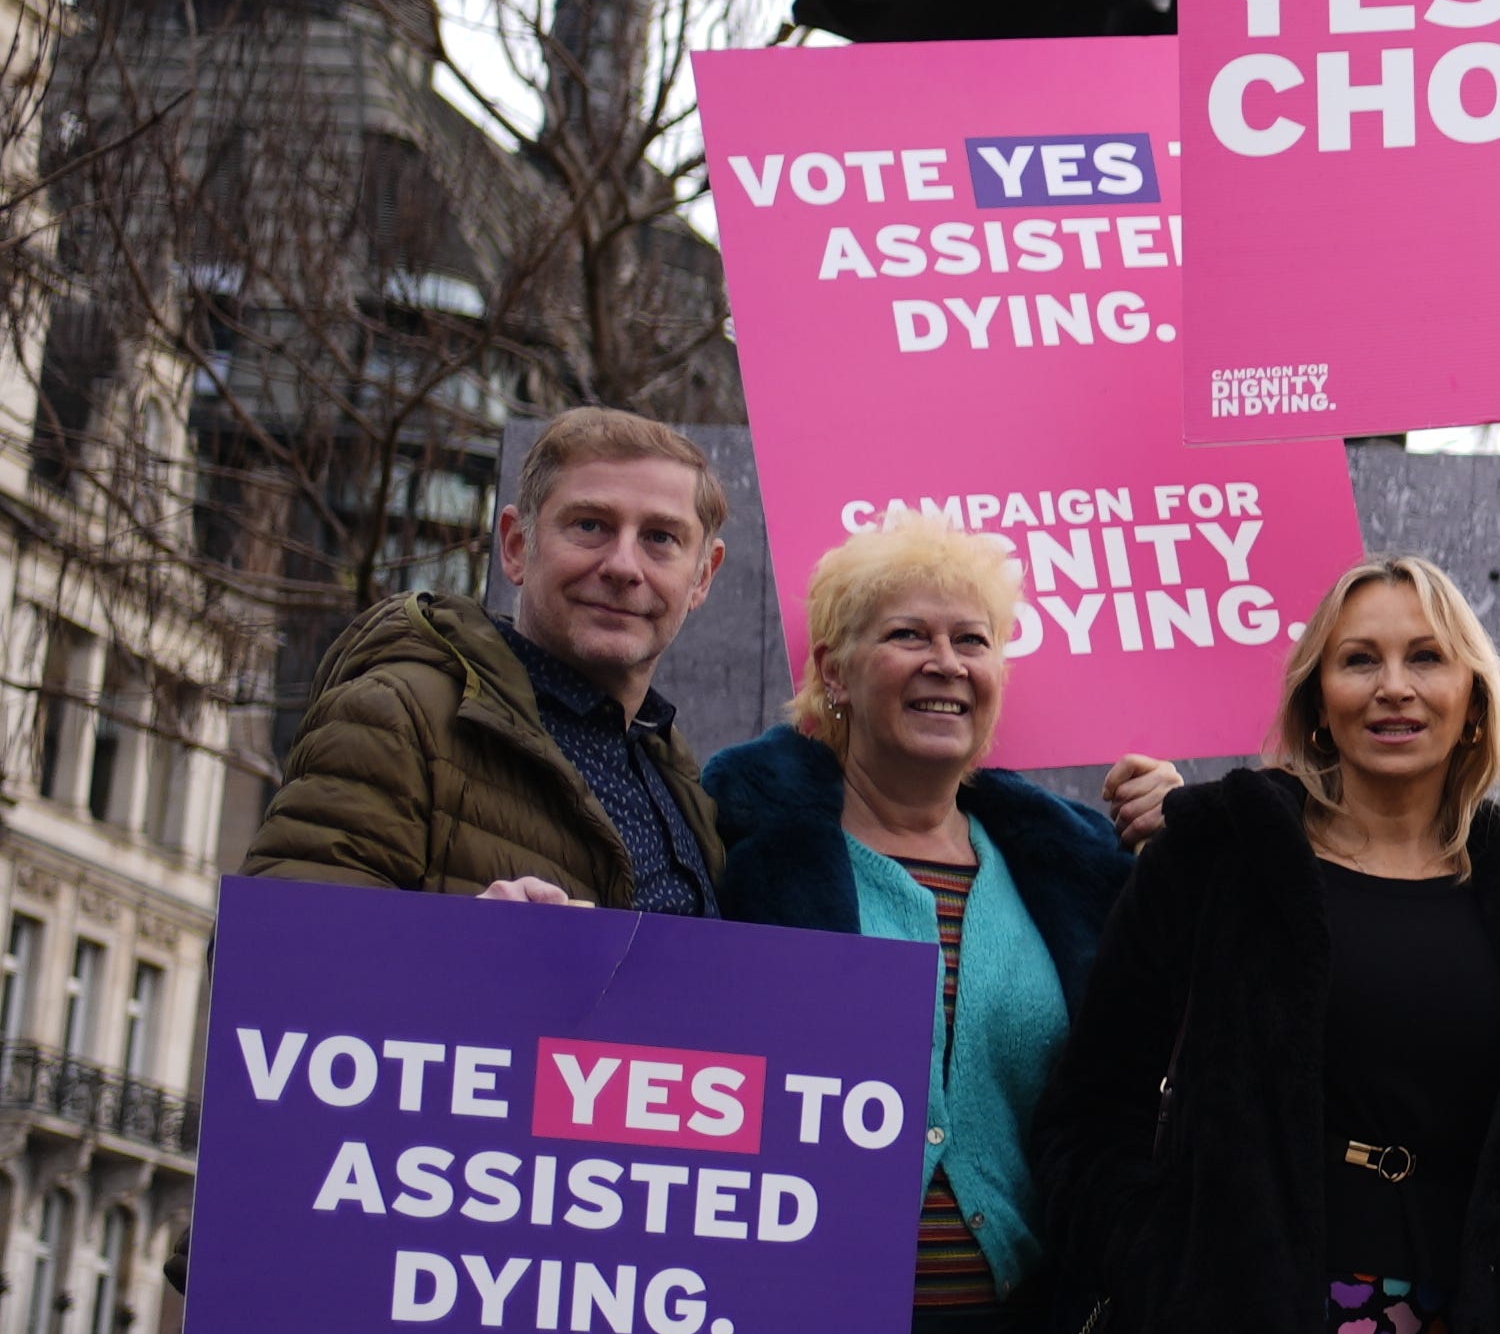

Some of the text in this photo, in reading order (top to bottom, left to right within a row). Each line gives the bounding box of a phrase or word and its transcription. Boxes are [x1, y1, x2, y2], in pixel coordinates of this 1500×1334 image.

[729, 143, 1142, 205] VOTE YES
[893, 292, 1175, 351] DYING.
[1212, 363, 1328, 380] CAMPAIGN FOR
[1212, 375, 1328, 399] DIGNITY
[1155, 483, 1260, 519] FOR
[237, 1029, 903, 1149] VOTE YES TO
[314, 1142, 817, 1241] ASSISTED
